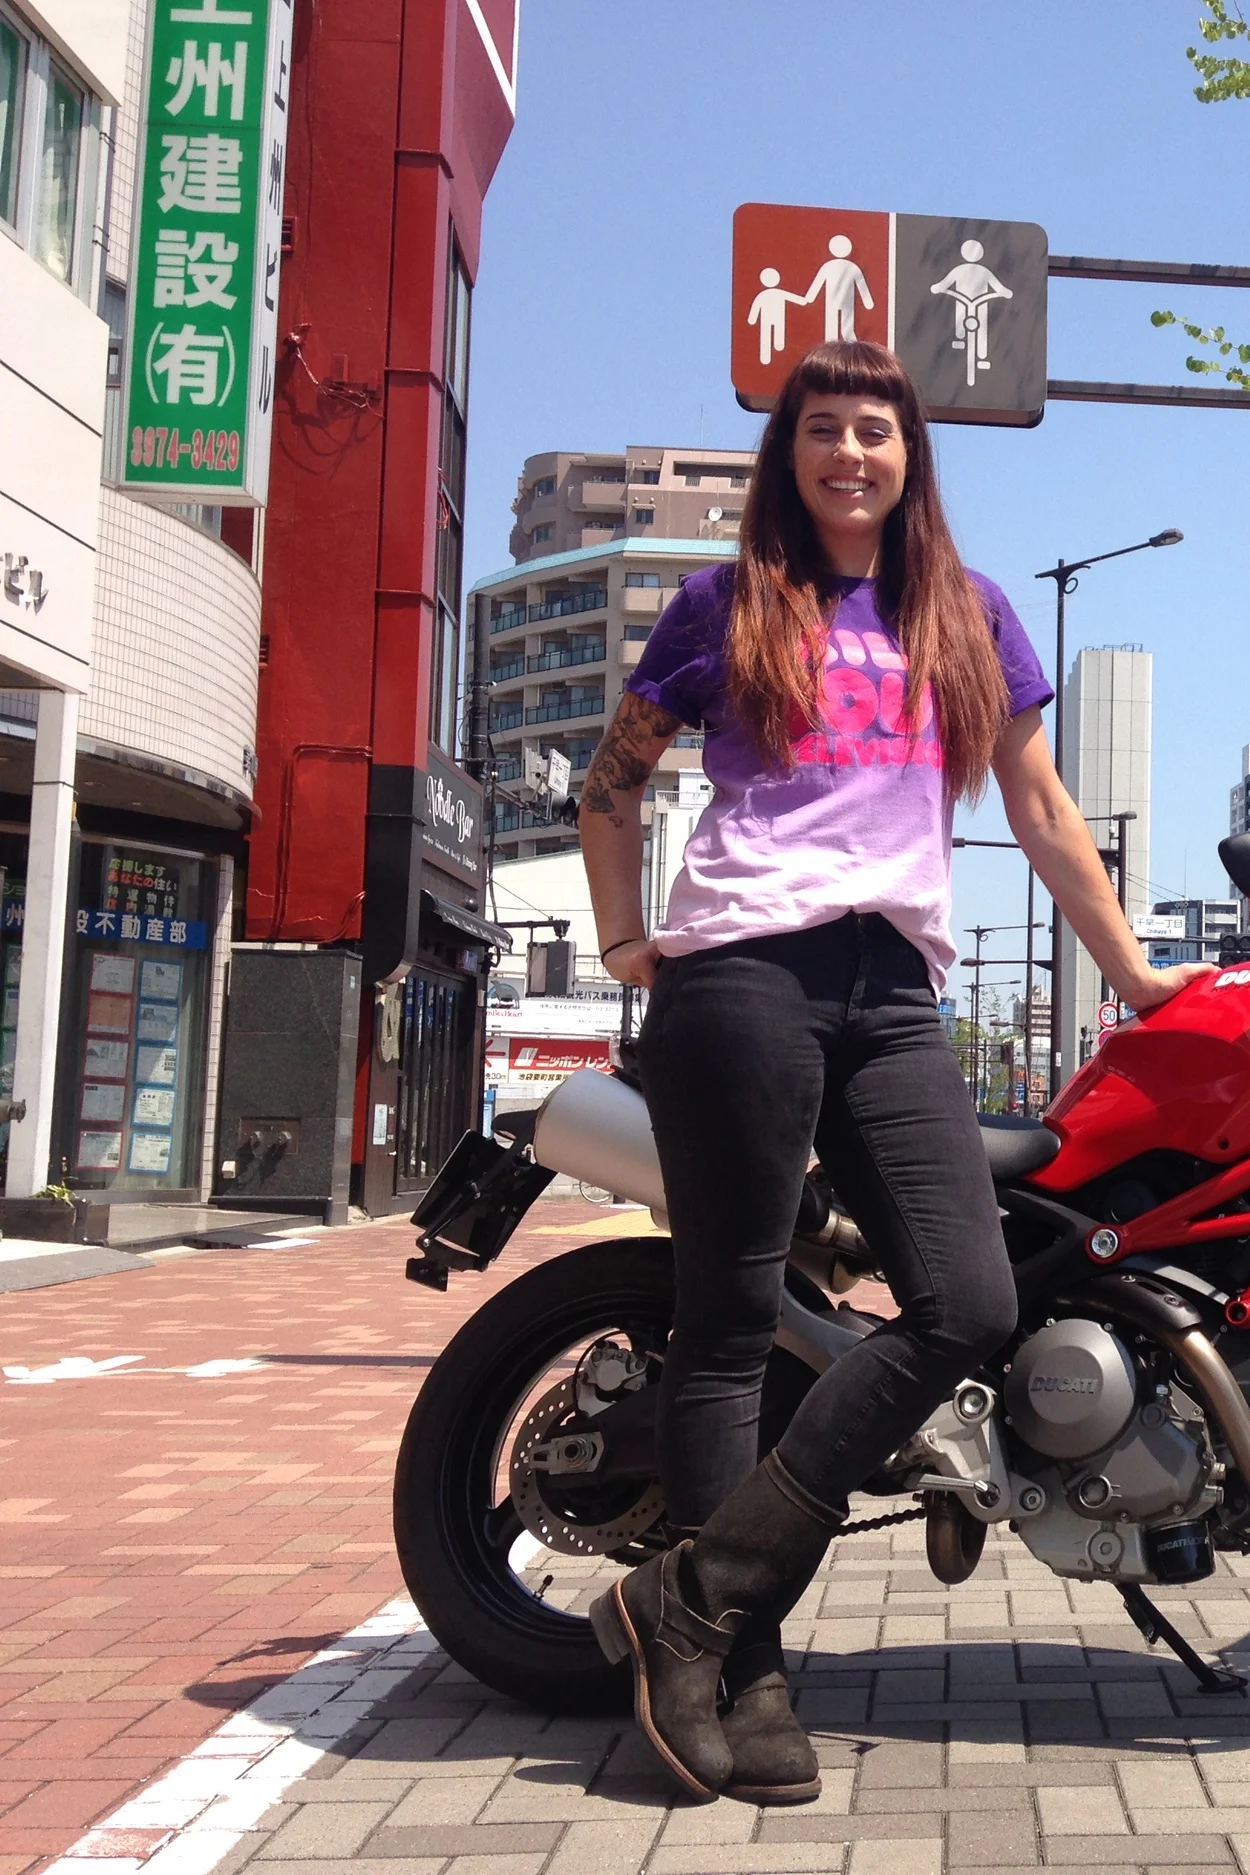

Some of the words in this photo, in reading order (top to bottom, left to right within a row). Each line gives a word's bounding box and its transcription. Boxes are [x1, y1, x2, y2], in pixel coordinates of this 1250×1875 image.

[131, 426, 240, 472] 3974-3429
[0, 552, 49, 615] ビル
[456, 799, 474, 843] Bar
[1136, 917, 1183, 929] 千早一丁目
[1103, 1009, 1116, 1022] 50
[535, 1053, 612, 1070] ニッポンレン
[1030, 1376, 1099, 1395] DUCATI
